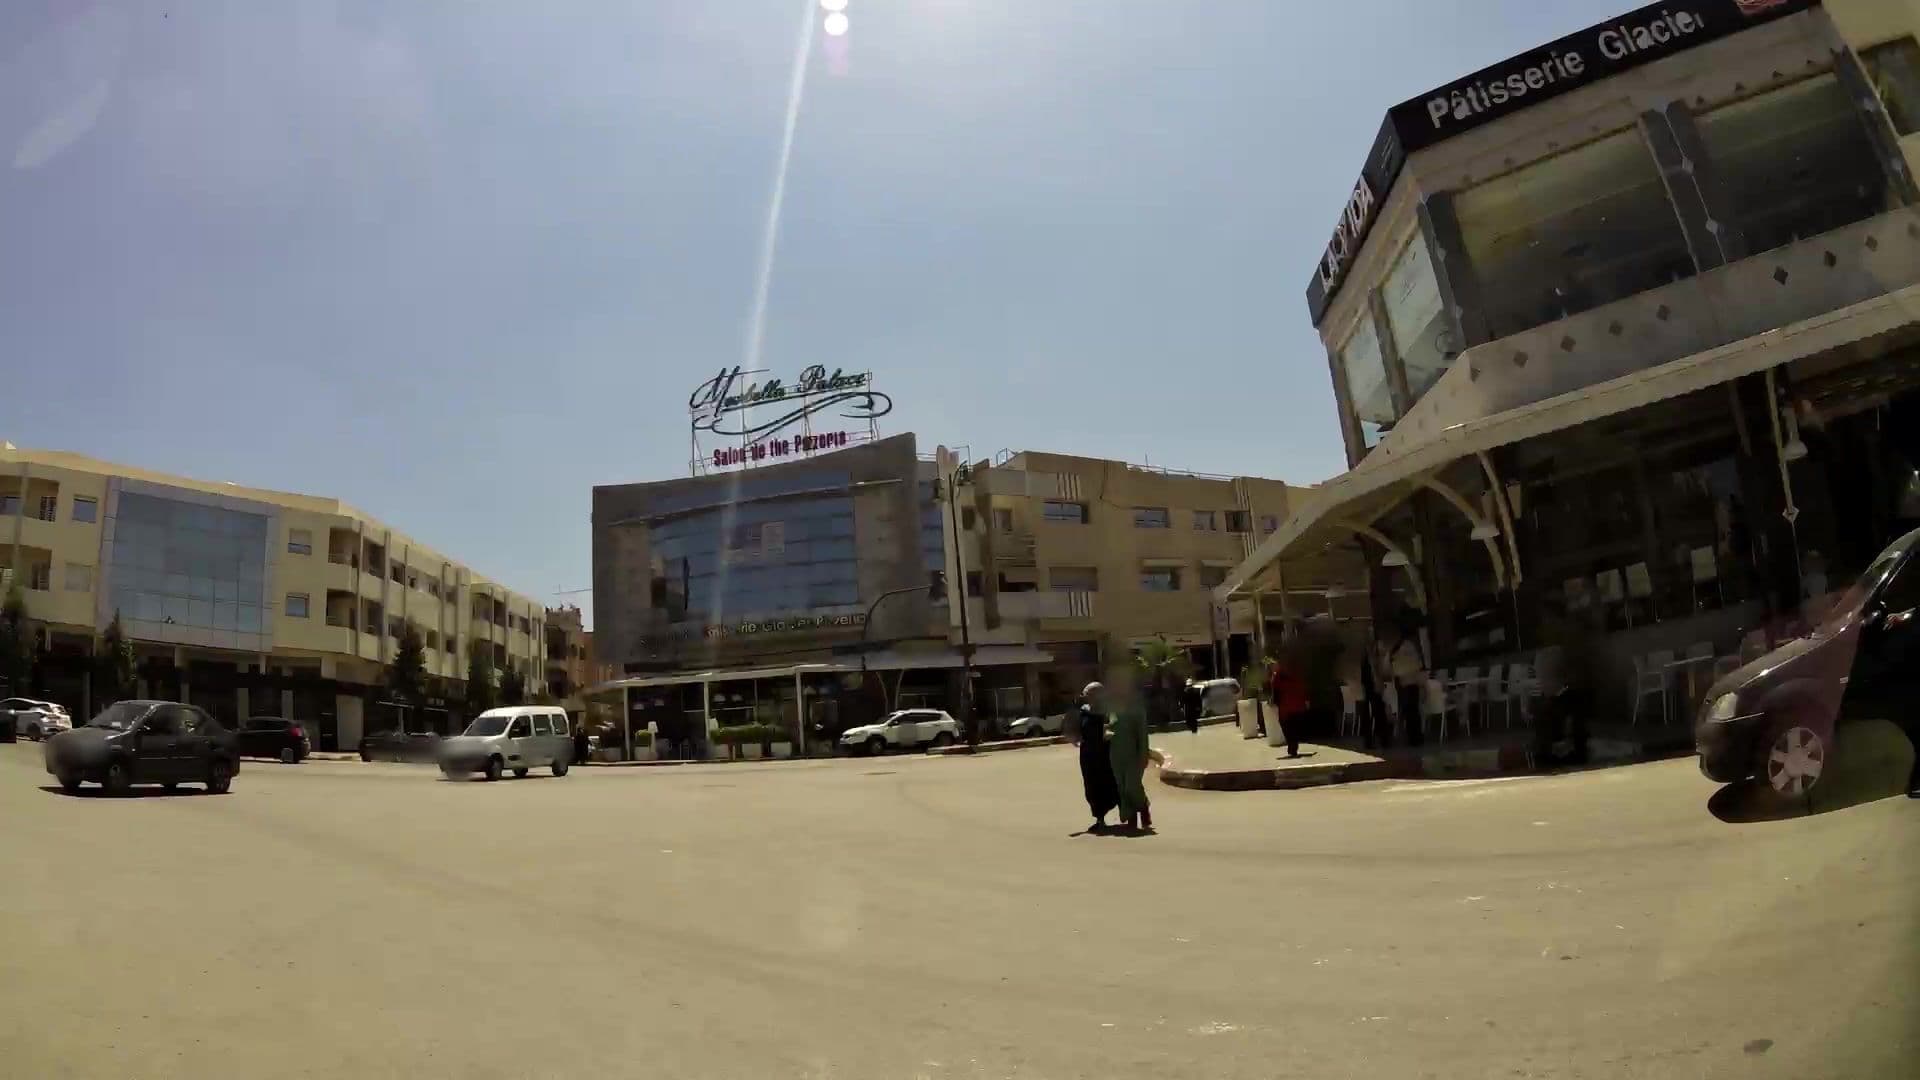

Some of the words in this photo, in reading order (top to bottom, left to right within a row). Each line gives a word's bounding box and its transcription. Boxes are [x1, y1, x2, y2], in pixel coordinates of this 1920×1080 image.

[1426, 50, 1586, 129] Pâtisserie
[713, 446, 747, 466] Salon
[750, 442, 766, 461] de
[769, 438, 789, 457] the
[794, 430, 847, 454] Pzeria
